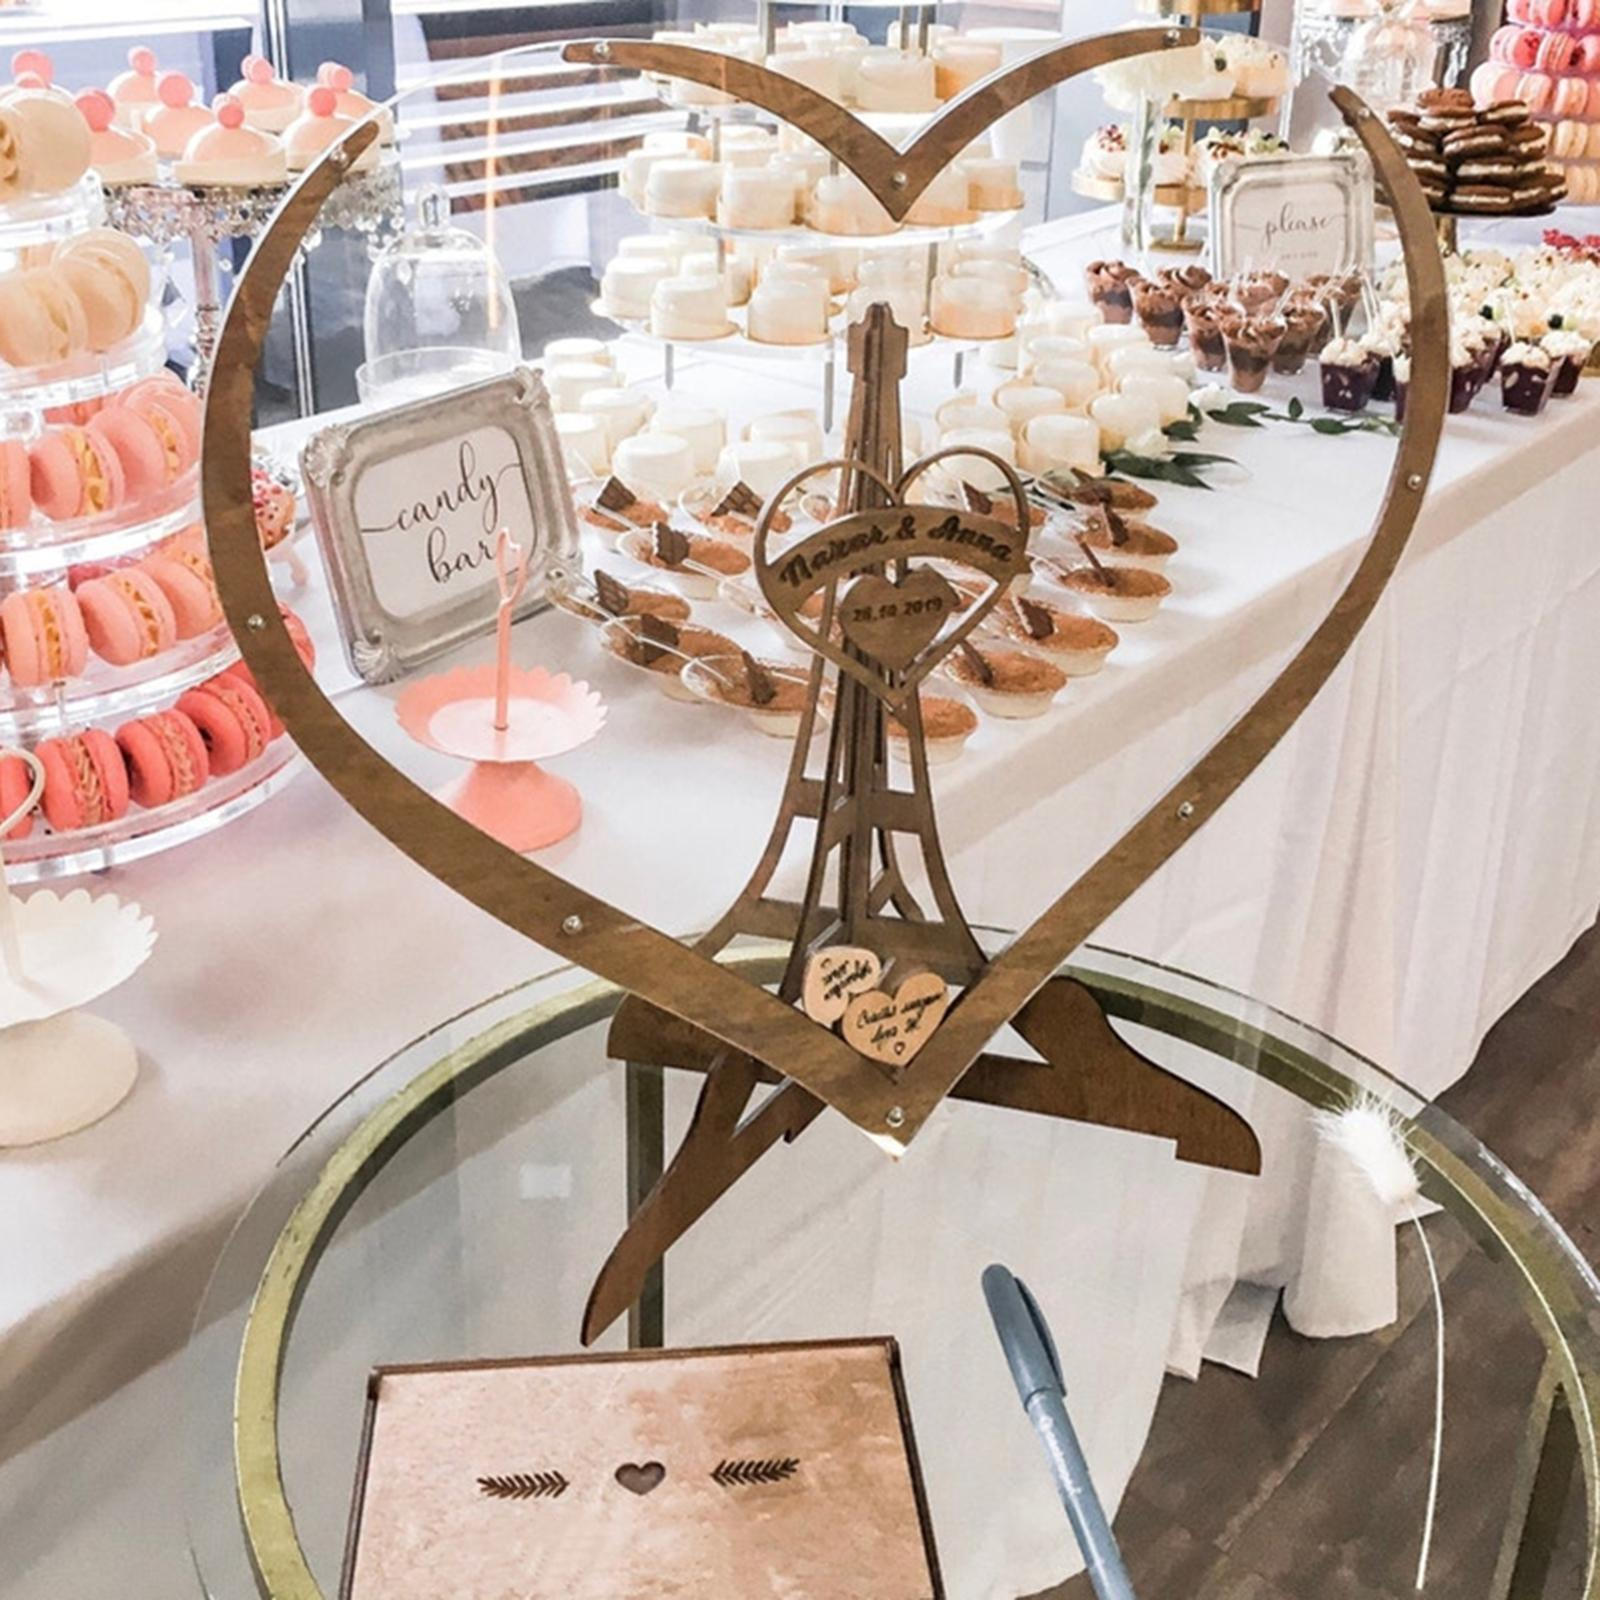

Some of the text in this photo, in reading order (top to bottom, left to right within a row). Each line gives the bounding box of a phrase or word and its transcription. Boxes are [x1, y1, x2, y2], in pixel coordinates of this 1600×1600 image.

[1238, 201, 1345, 254] please
[361, 440, 521, 534] candy
[427, 526, 495, 583] bar
[895, 514, 918, 541] &
[927, 514, 1012, 562] Anna
